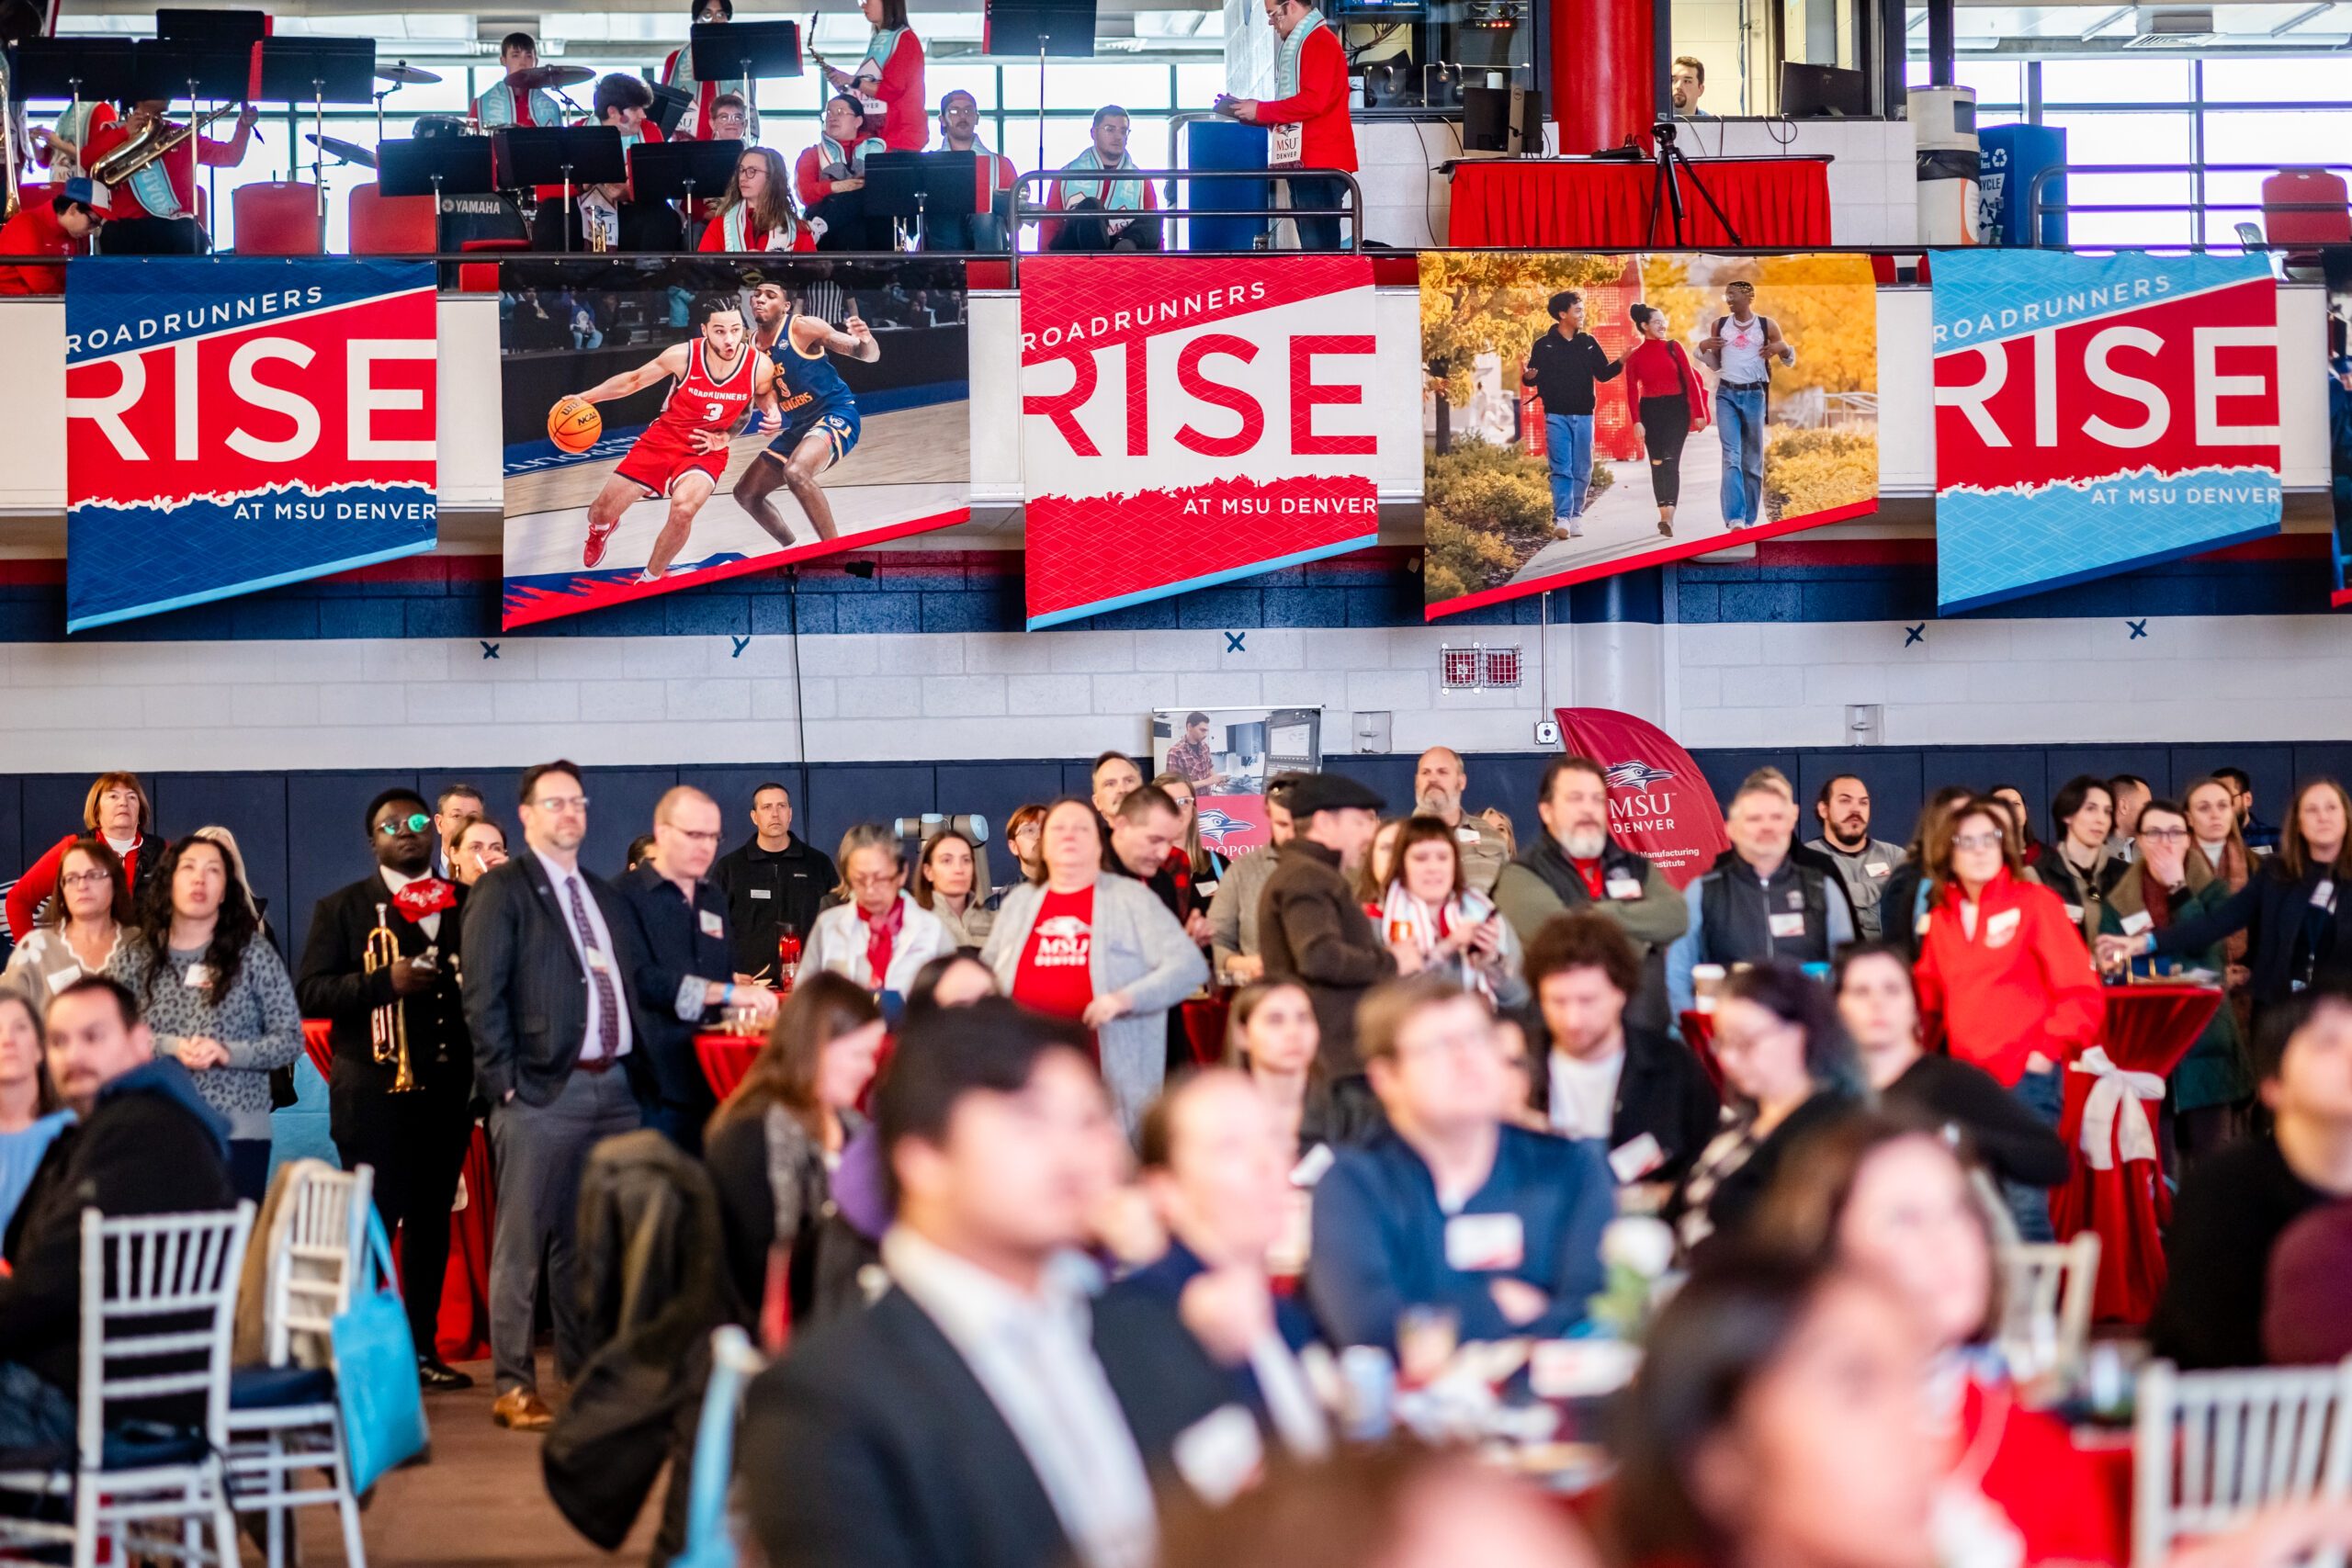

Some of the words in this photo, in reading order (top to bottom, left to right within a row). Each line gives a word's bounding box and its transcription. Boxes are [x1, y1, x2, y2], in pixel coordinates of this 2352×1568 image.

[1276, 137, 1296, 152] MSU
[1276, 151, 1297, 161] DENVER
[455, 199, 501, 214] YAMAHA
[1022, 282, 1266, 352] ROADRUNNERS
[1934, 276, 2171, 343] ROADRUNNERS
[67, 286, 323, 355] ROADRUNNERS
[687, 387, 748, 401] ROADRUNNERS
[1023, 333, 1377, 457] RISE
[1935, 326, 2280, 447] RISE
[67, 336, 436, 462] RISE
[702, 402, 724, 422] 3
[2091, 488, 2120, 504] AT
[2129, 488, 2177, 504] MSU
[2187, 488, 2280, 504] DENVER
[234, 502, 265, 520] AT
[275, 502, 325, 520] MSU
[337, 502, 436, 520] DENVER
[1183, 498, 1211, 514] AT
[1222, 497, 1271, 514] MSU
[1281, 497, 1377, 514] DENVER
[1609, 793, 1672, 819] MSU
[1612, 818, 1675, 834] DENVER
[1640, 847, 1700, 859] Manufacturing
[1653, 859, 1686, 868] nstitute
[1037, 938, 1090, 955] MSU
